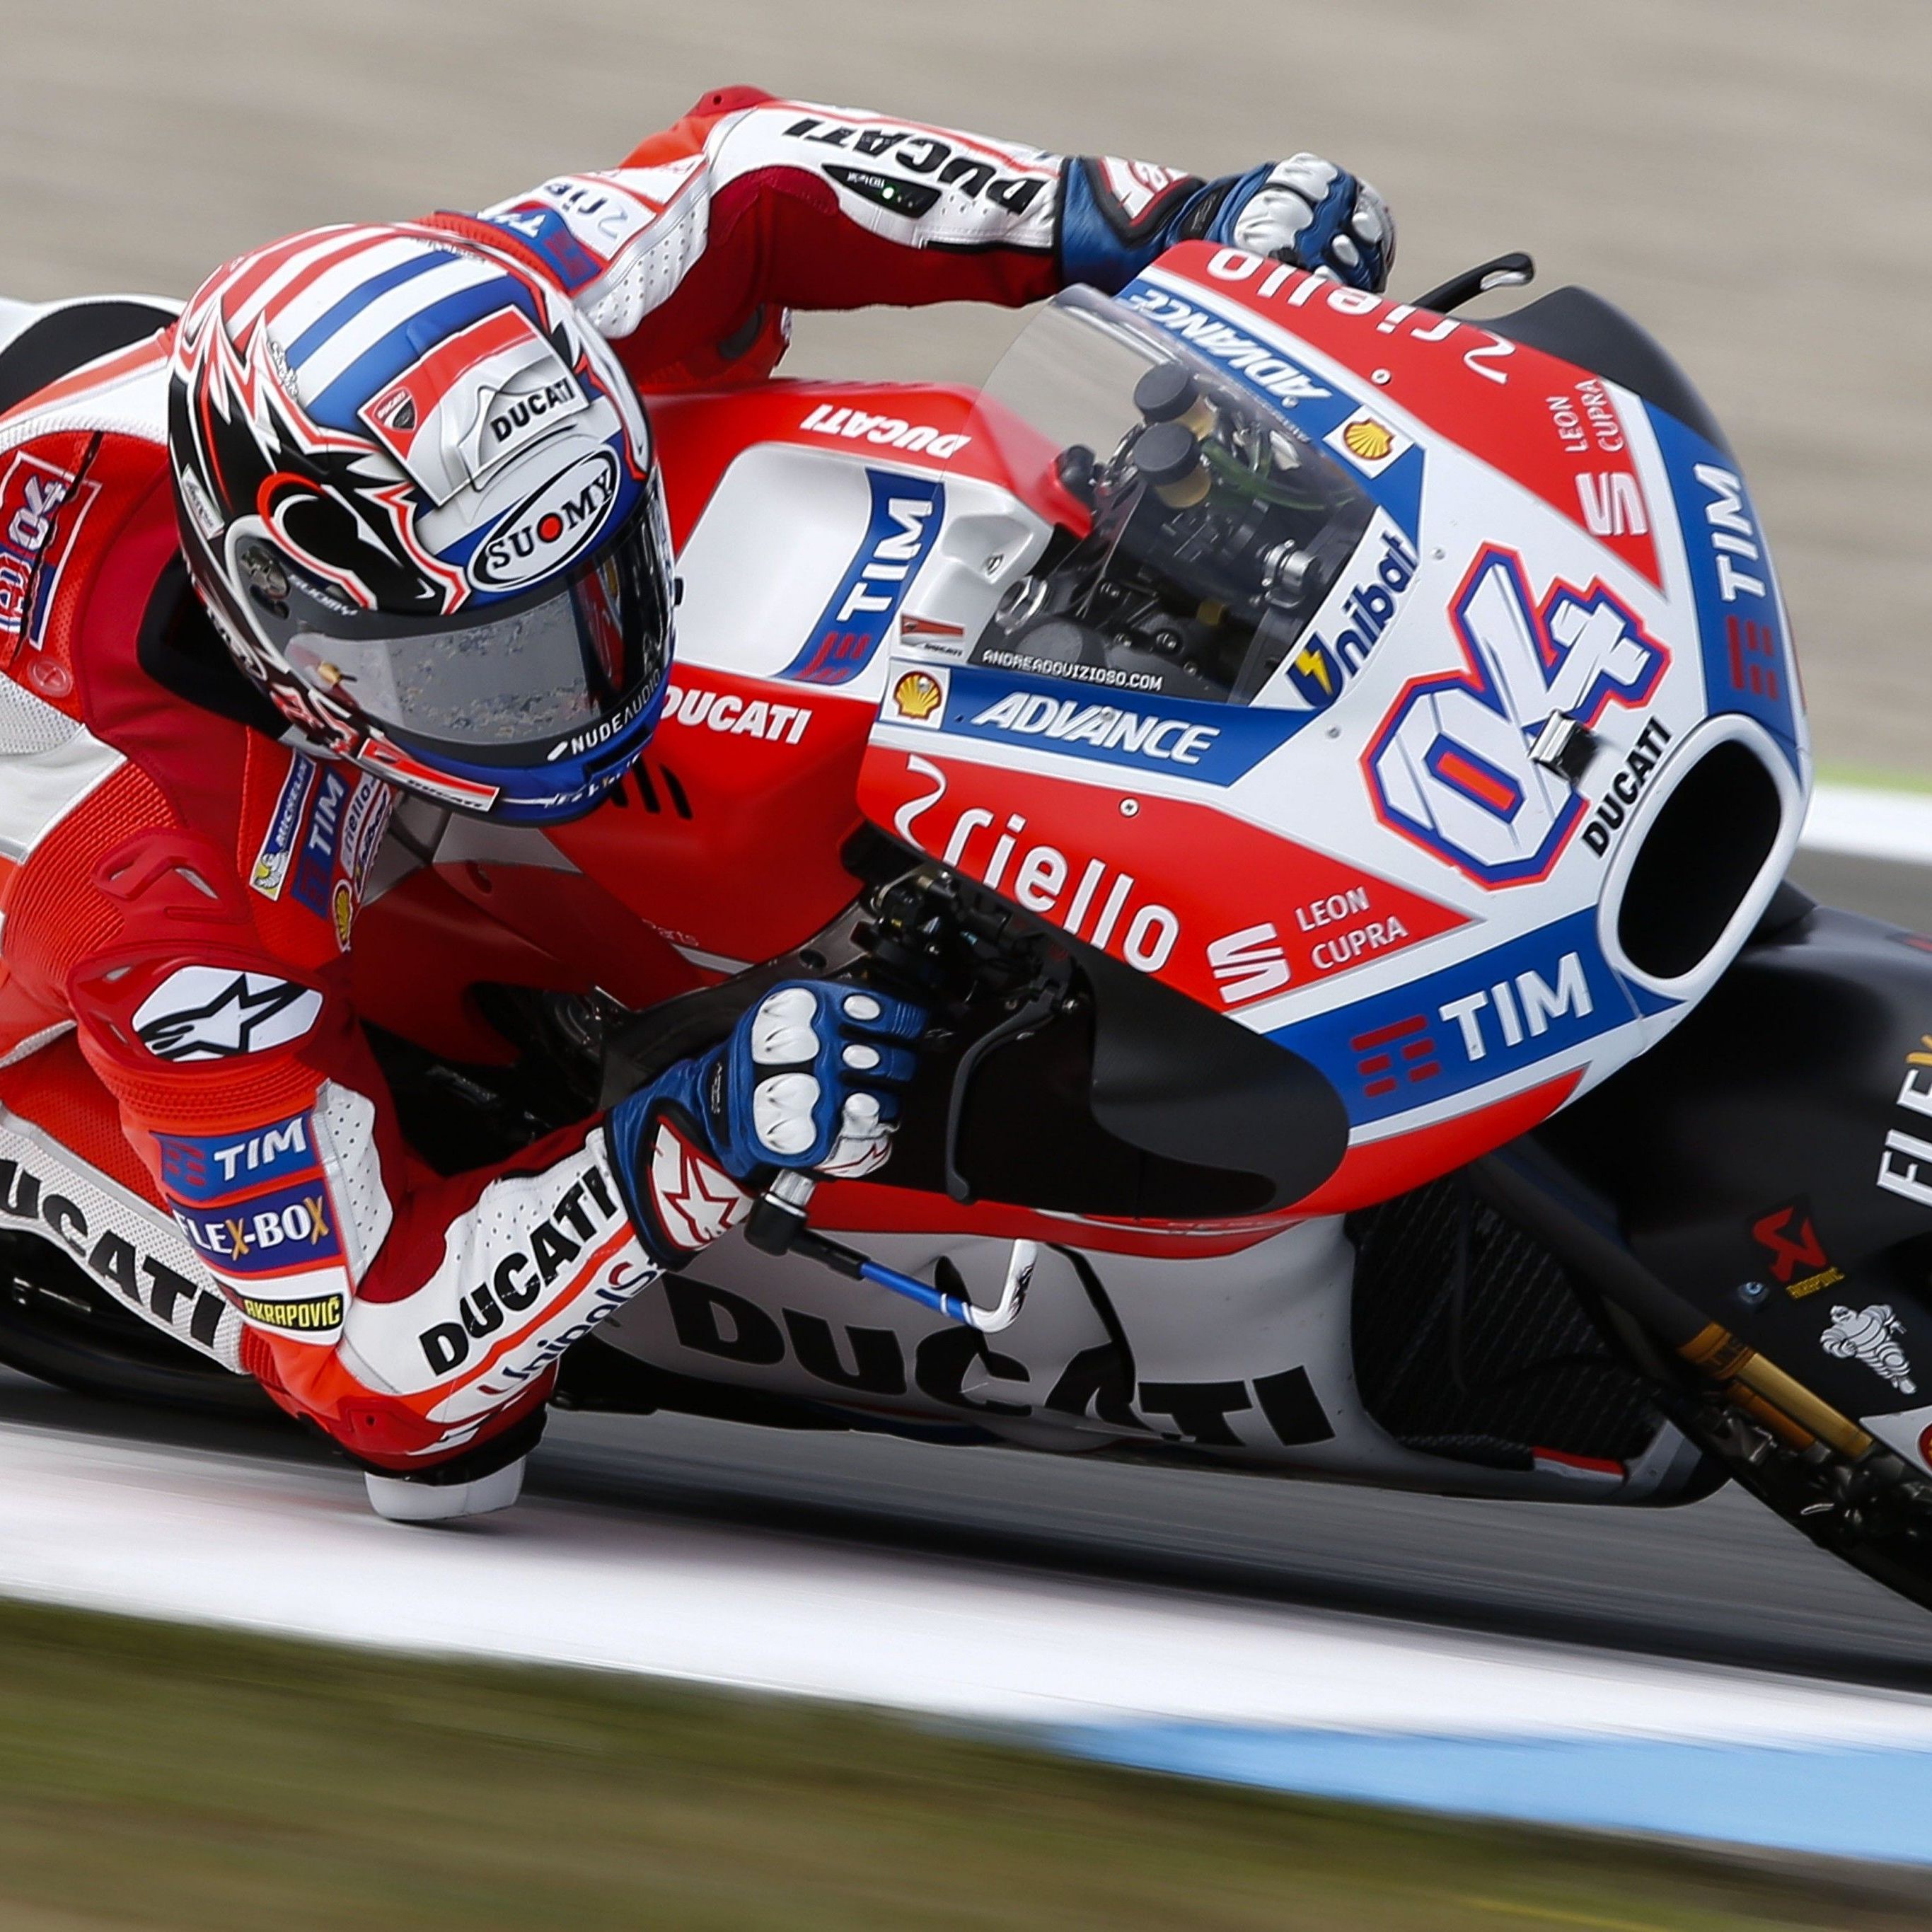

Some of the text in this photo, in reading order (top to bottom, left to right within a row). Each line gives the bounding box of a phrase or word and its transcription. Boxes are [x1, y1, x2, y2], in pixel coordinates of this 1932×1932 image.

[782, 117, 1050, 214] DUCATI
[1129, 289, 1333, 398] ADVANCE
[490, 378, 574, 443] DUCATI
[799, 403, 973, 459] DUCATI
[1546, 395, 1588, 453] LEON
[1575, 379, 1626, 452] CUPRA
[485, 467, 613, 570] SUOMY
[835, 497, 933, 623] TIM
[1693, 462, 1766, 603] TIM
[1285, 528, 1421, 710] Unibat
[661, 685, 812, 745] DUCATI
[971, 693, 1220, 765] ADVANCE
[1358, 540, 1674, 892] 04
[308, 773, 345, 857] TIM
[1582, 716, 1672, 860] DUCATI
[943, 808, 1180, 973] riello
[1294, 886, 1371, 933] LEON
[1310, 915, 1409, 971] CUPRA
[1438, 951, 1595, 1062] TIM
[213, 1116, 308, 1181] TIM
[418, 1164, 618, 1377] DUCATI
[662, 1273, 1336, 1447] DUCATI
